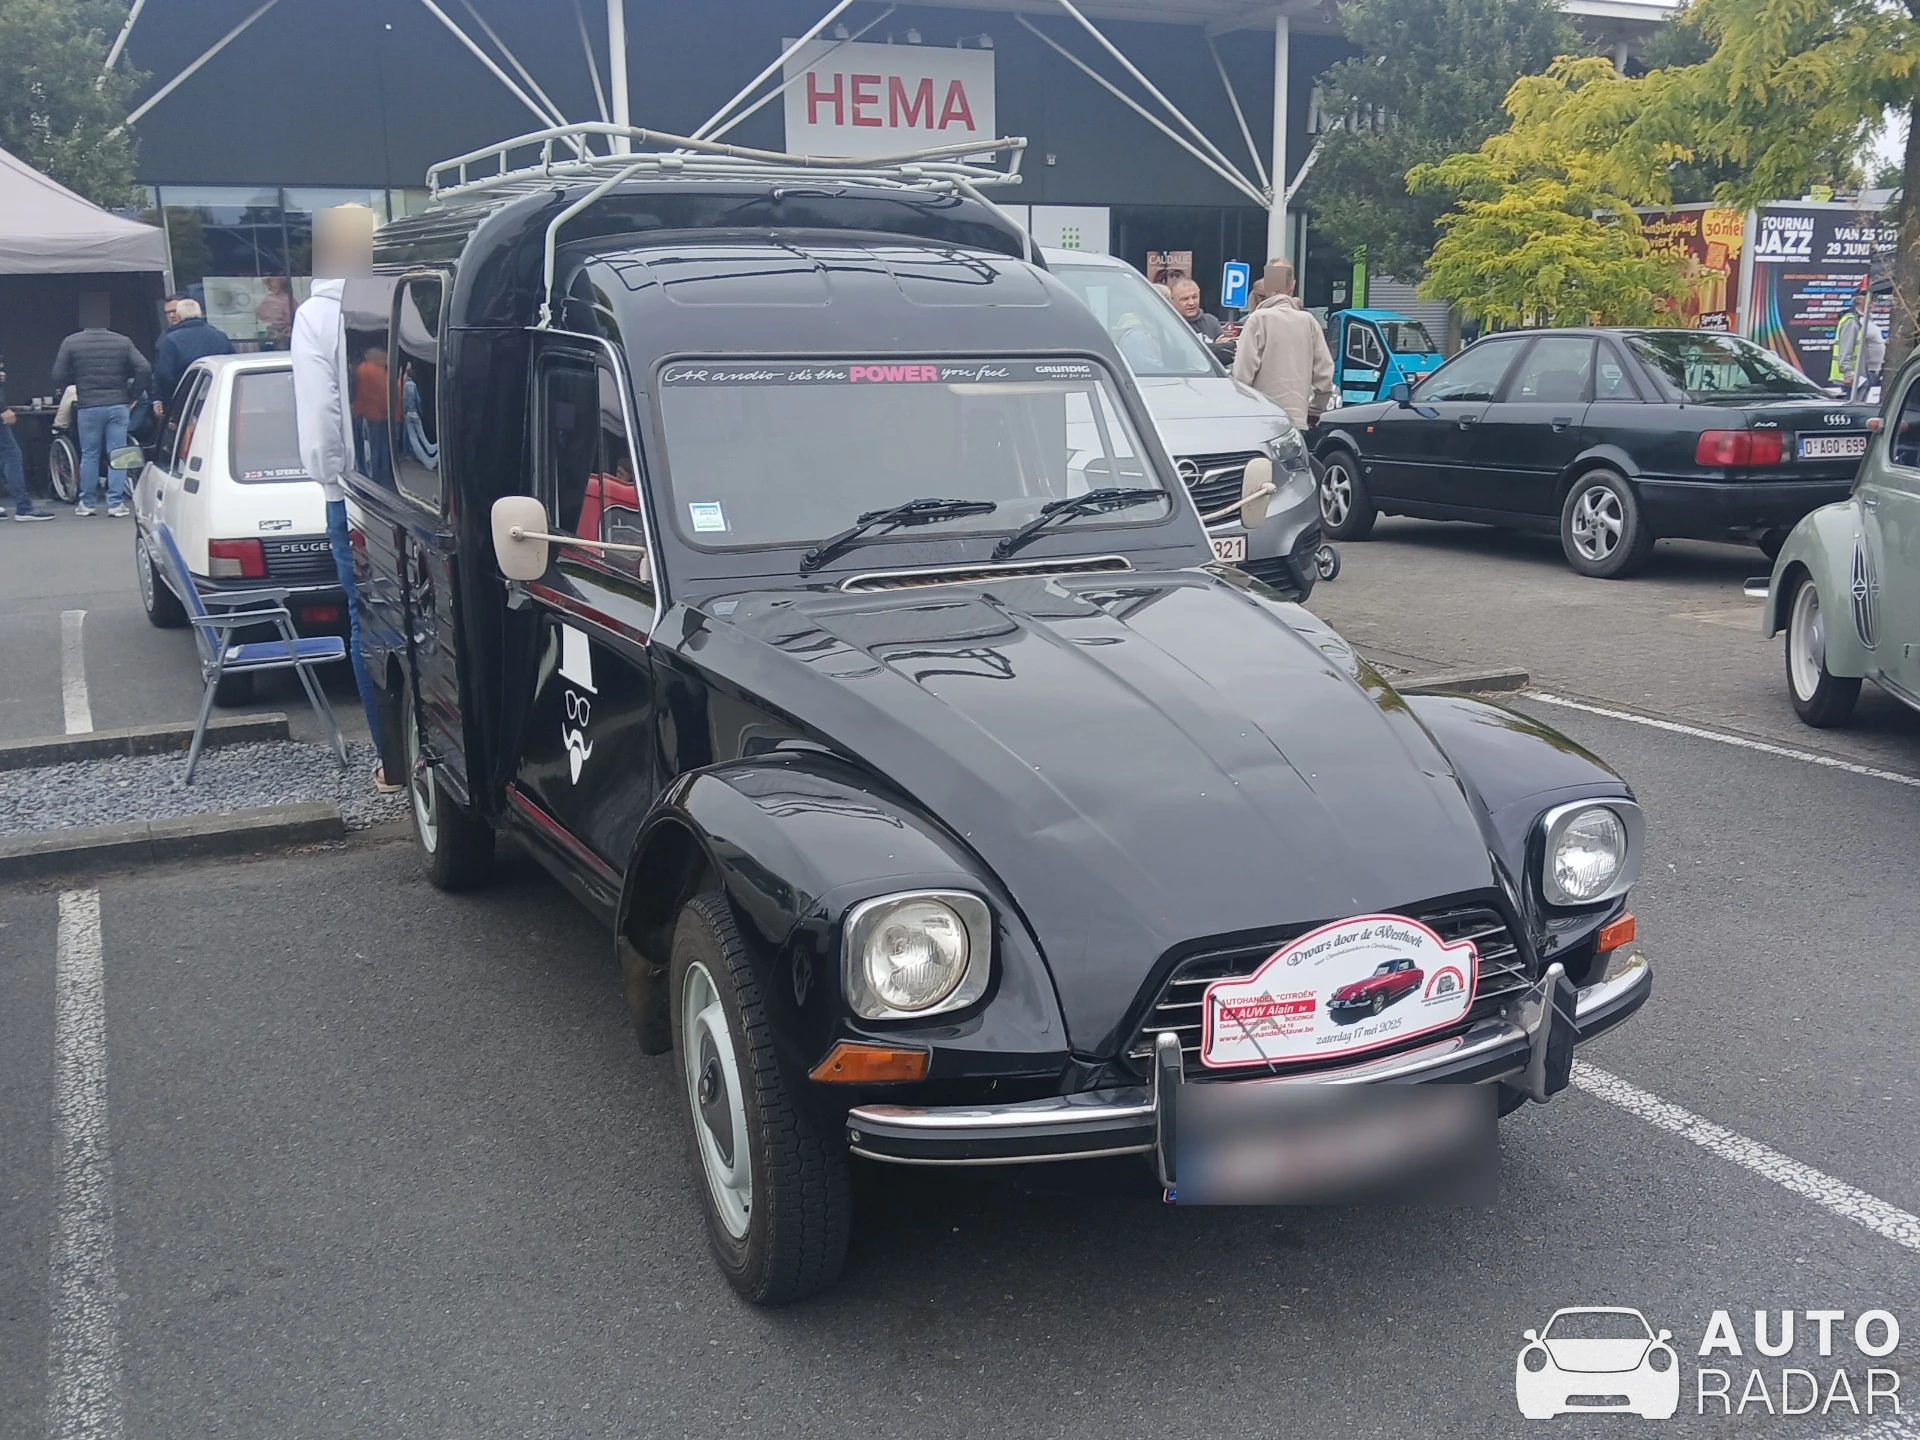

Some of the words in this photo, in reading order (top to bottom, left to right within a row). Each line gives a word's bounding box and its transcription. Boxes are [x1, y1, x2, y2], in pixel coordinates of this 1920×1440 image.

[806, 71, 976, 131] HEMA
[1705, 222, 1721, 237] 30
[1762, 216, 1815, 230] TOURNAI
[1834, 227, 1860, 241] VAN
[1861, 228, 1875, 241] 25
[1754, 230, 1814, 254] JAZZ
[1826, 242, 1842, 255] 29
[1842, 243, 1871, 256] JUNI
[1148, 254, 1192, 265] CAUDALIE
[1225, 269, 1245, 300] P
[664, 368, 709, 383] CAR
[711, 369, 784, 382] audio
[814, 369, 848, 381] the
[849, 365, 939, 383] POWER
[940, 367, 976, 383] you
[975, 364, 1010, 382] feel
[1035, 365, 1091, 373] GRUNDIG
[1286, 939, 1332, 967] Dwars
[1333, 931, 1360, 947] door
[1360, 928, 1373, 940] de
[1374, 924, 1423, 948] Westhoek
[1266, 1004, 1294, 1016] Alain
[1316, 1030, 1352, 1045] zaterdag
[1352, 1026, 1364, 1039] 17
[1364, 1023, 1379, 1035] mei
[1379, 1017, 1403, 1033] 2025
